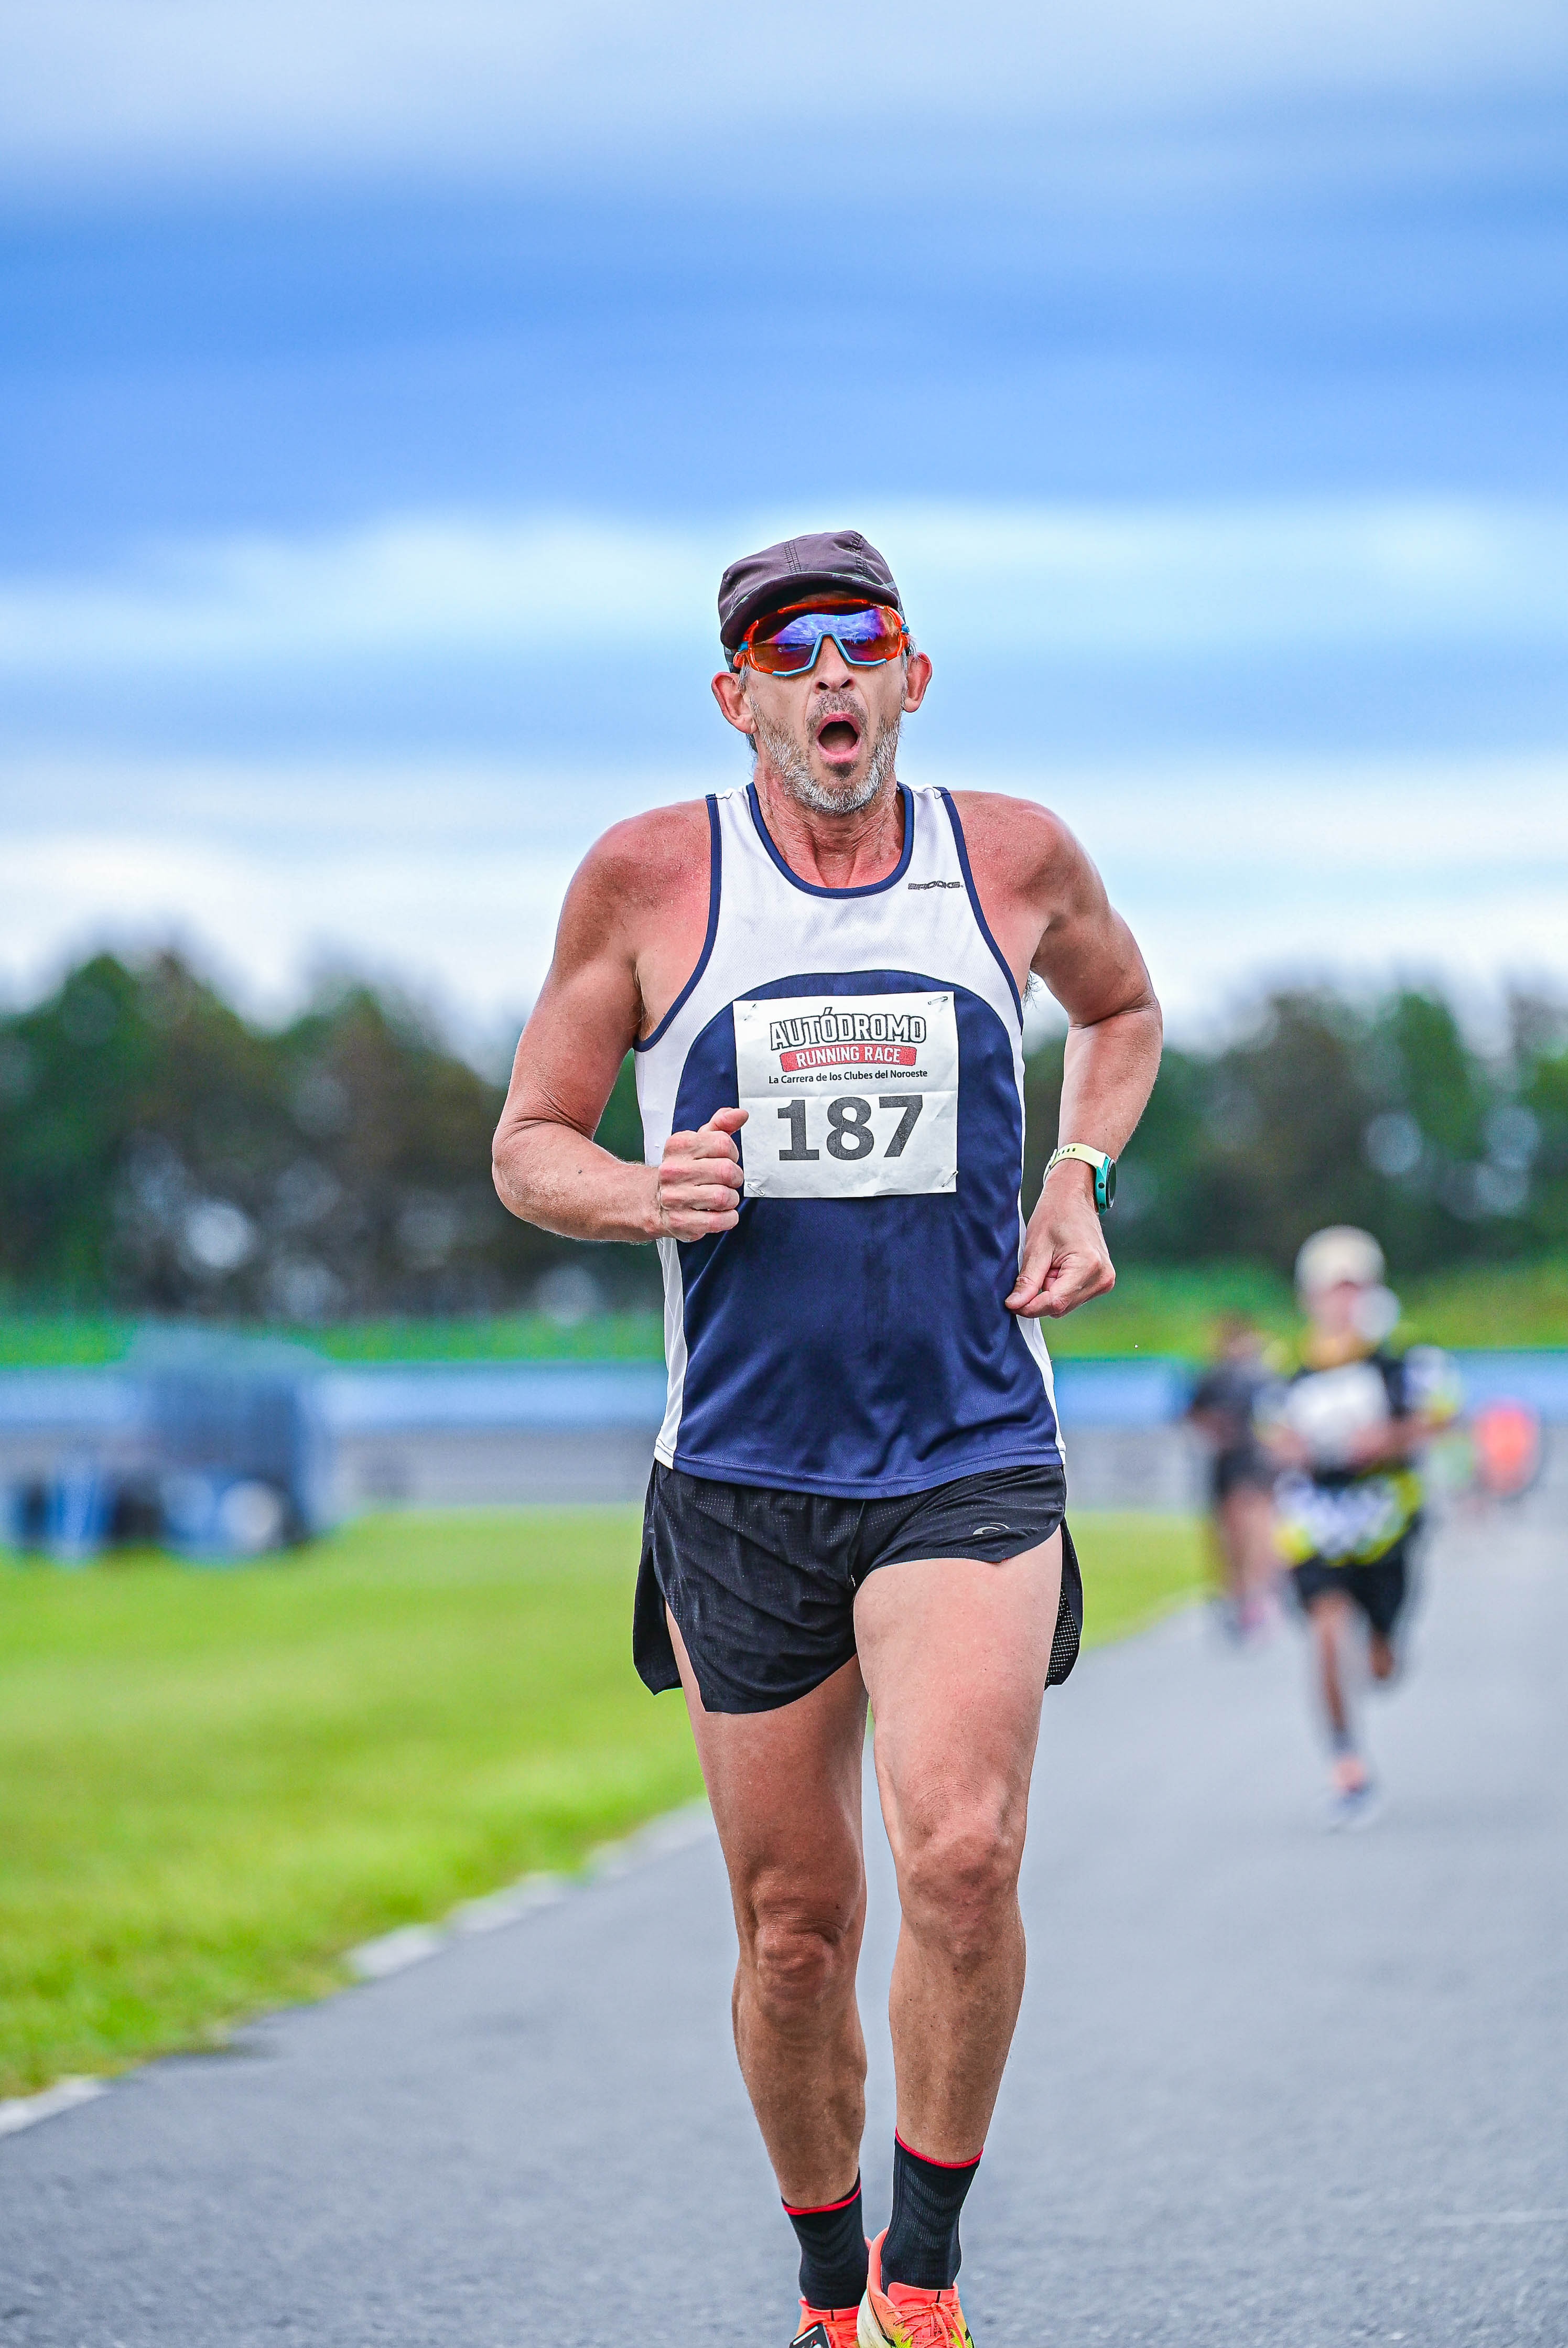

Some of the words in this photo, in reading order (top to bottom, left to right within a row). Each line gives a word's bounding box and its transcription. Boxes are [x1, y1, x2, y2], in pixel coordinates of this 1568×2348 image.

[770, 1007, 926, 1050] AUTÓDROMO
[796, 1047, 860, 1068] RUNNING
[864, 1047, 901, 1063] RACE
[781, 1074, 813, 1083] Carrera
[816, 1073, 827, 1082] de
[844, 1071, 873, 1080] Clubes
[875, 1070, 888, 1079] del
[890, 1070, 927, 1078] Noroeste
[777, 1095, 923, 1161] 187
